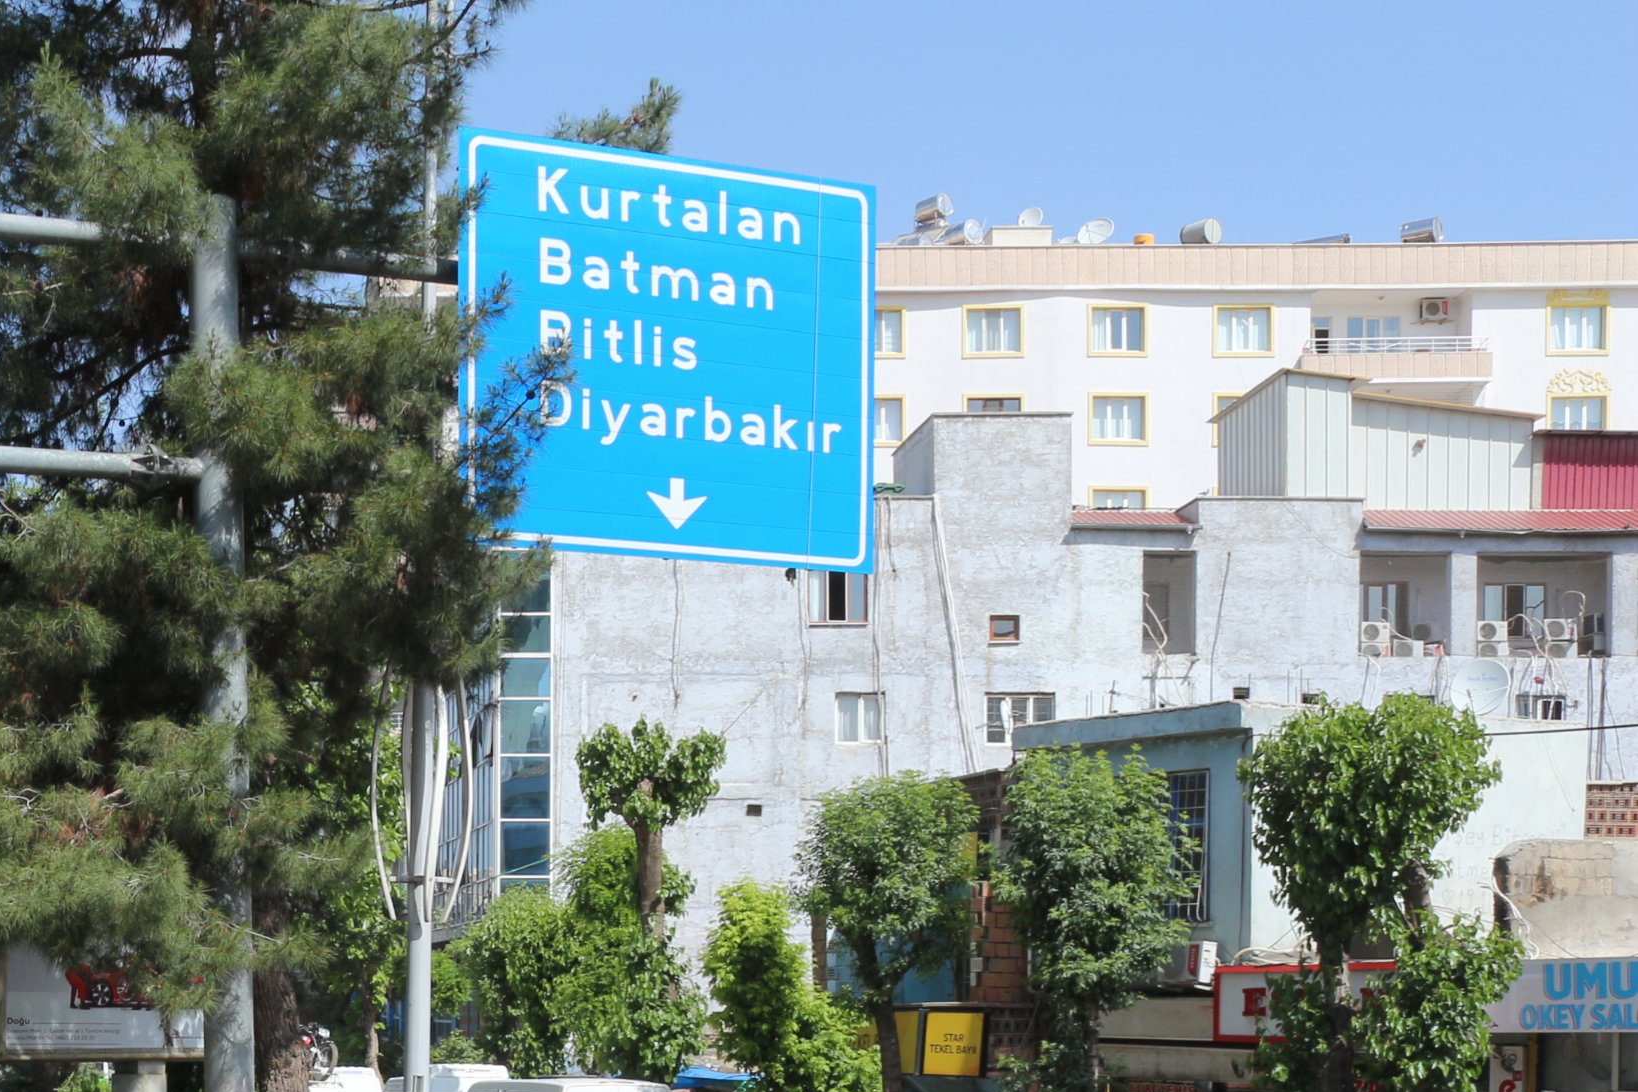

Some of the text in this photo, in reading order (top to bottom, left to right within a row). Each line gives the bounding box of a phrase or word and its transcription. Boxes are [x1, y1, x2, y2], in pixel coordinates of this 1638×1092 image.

[536, 165, 802, 245] Kurtalan
[539, 237, 775, 312] Batman
[539, 309, 698, 371] Bitlis
[539, 379, 843, 454] Diyarbakır
[7, 1017, 30, 1026] Doğu
[943, 1033, 964, 1042] STAR
[1520, 1003, 1638, 1030] OKEY SAL
[930, 1044, 954, 1054] TEKEL
